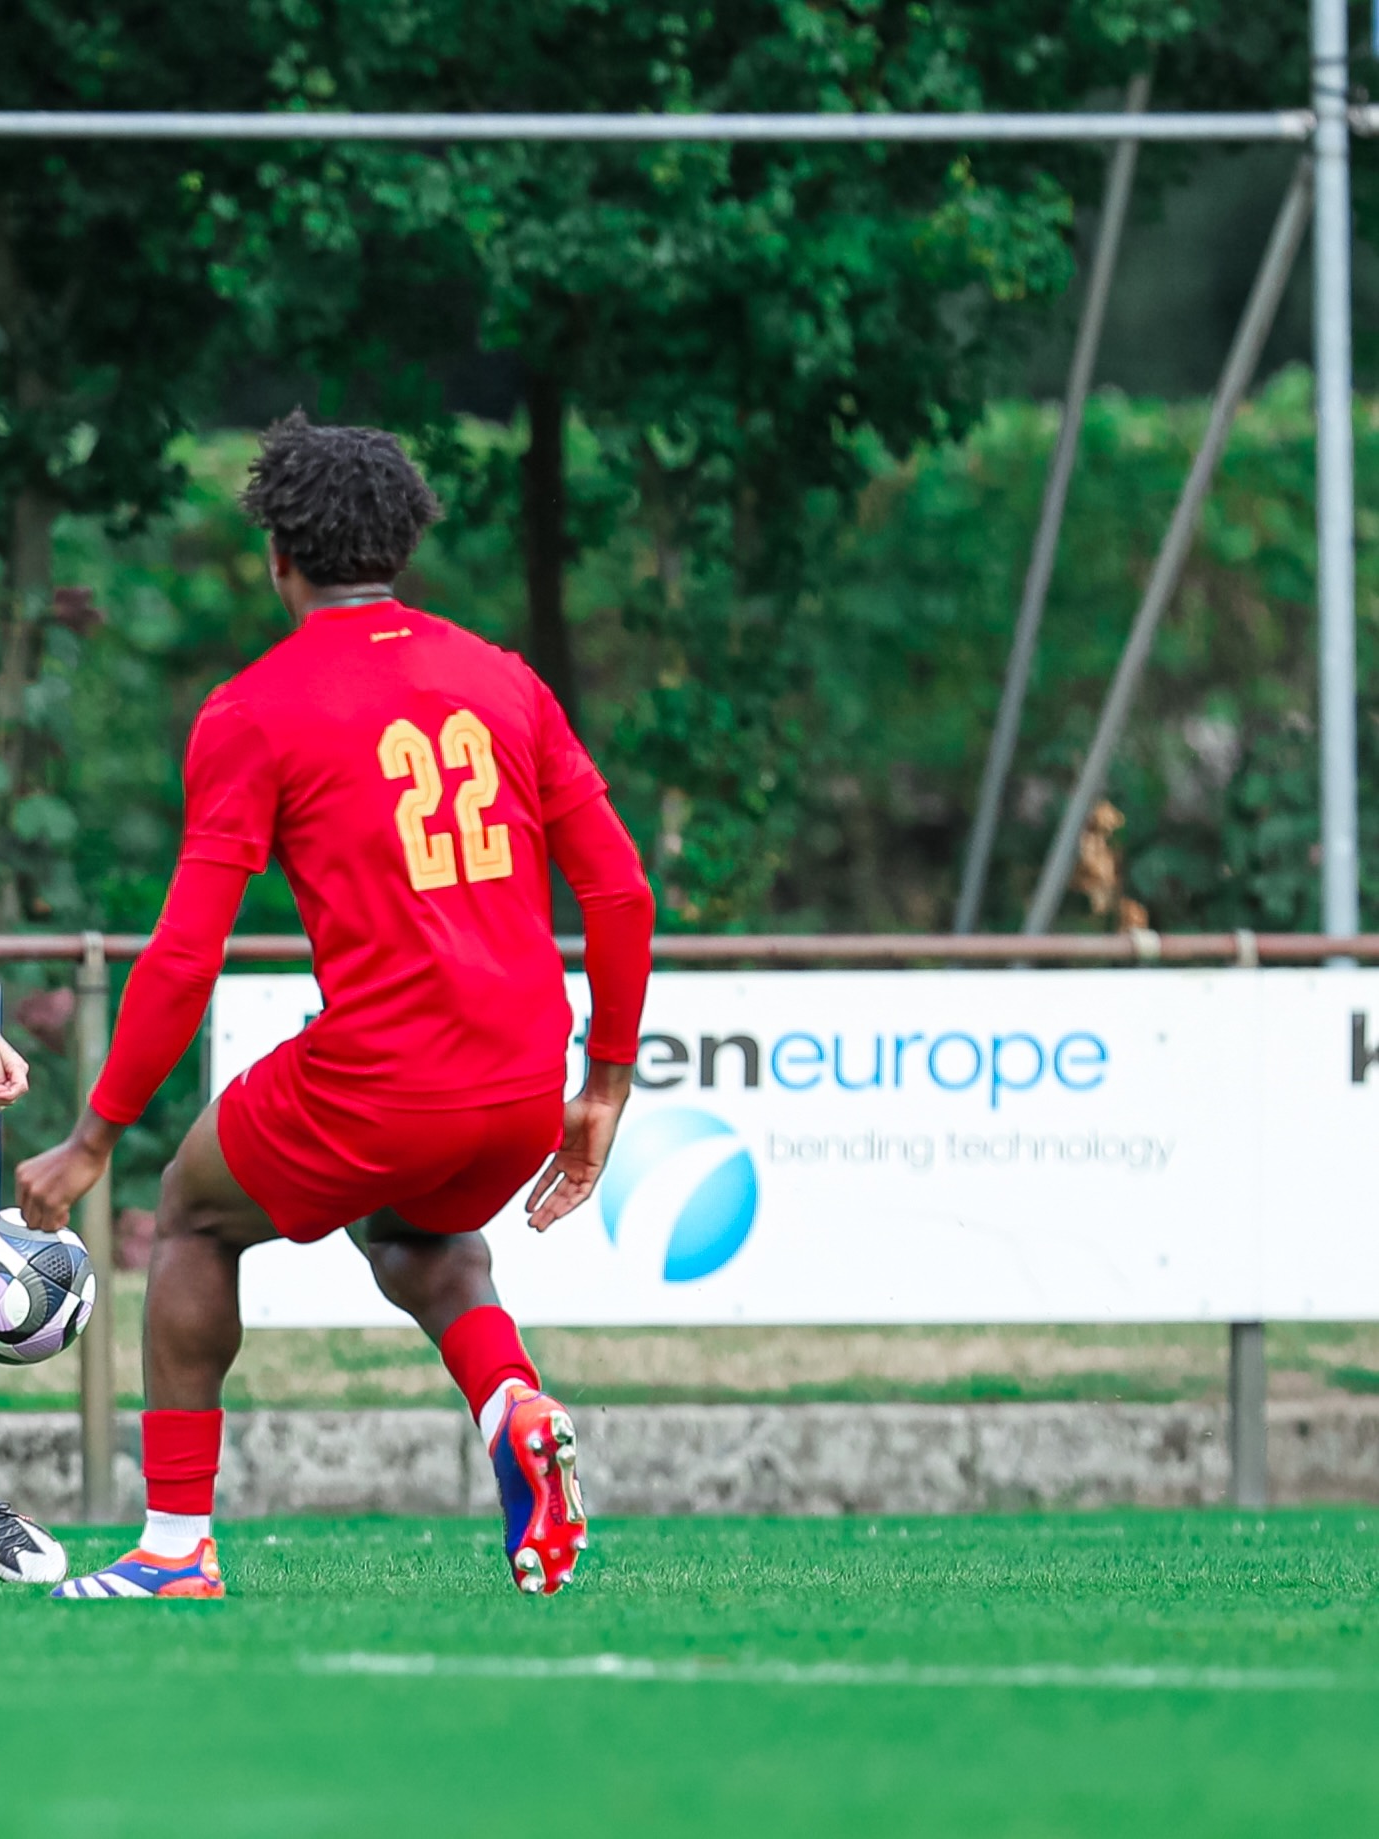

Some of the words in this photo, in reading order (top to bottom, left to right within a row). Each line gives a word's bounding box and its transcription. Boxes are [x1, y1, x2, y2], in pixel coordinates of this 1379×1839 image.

[377, 708, 513, 892] 22
[574, 1018, 1109, 1111] eneurope
[768, 1129, 935, 1170] bending
[946, 1129, 1176, 1170] technology
